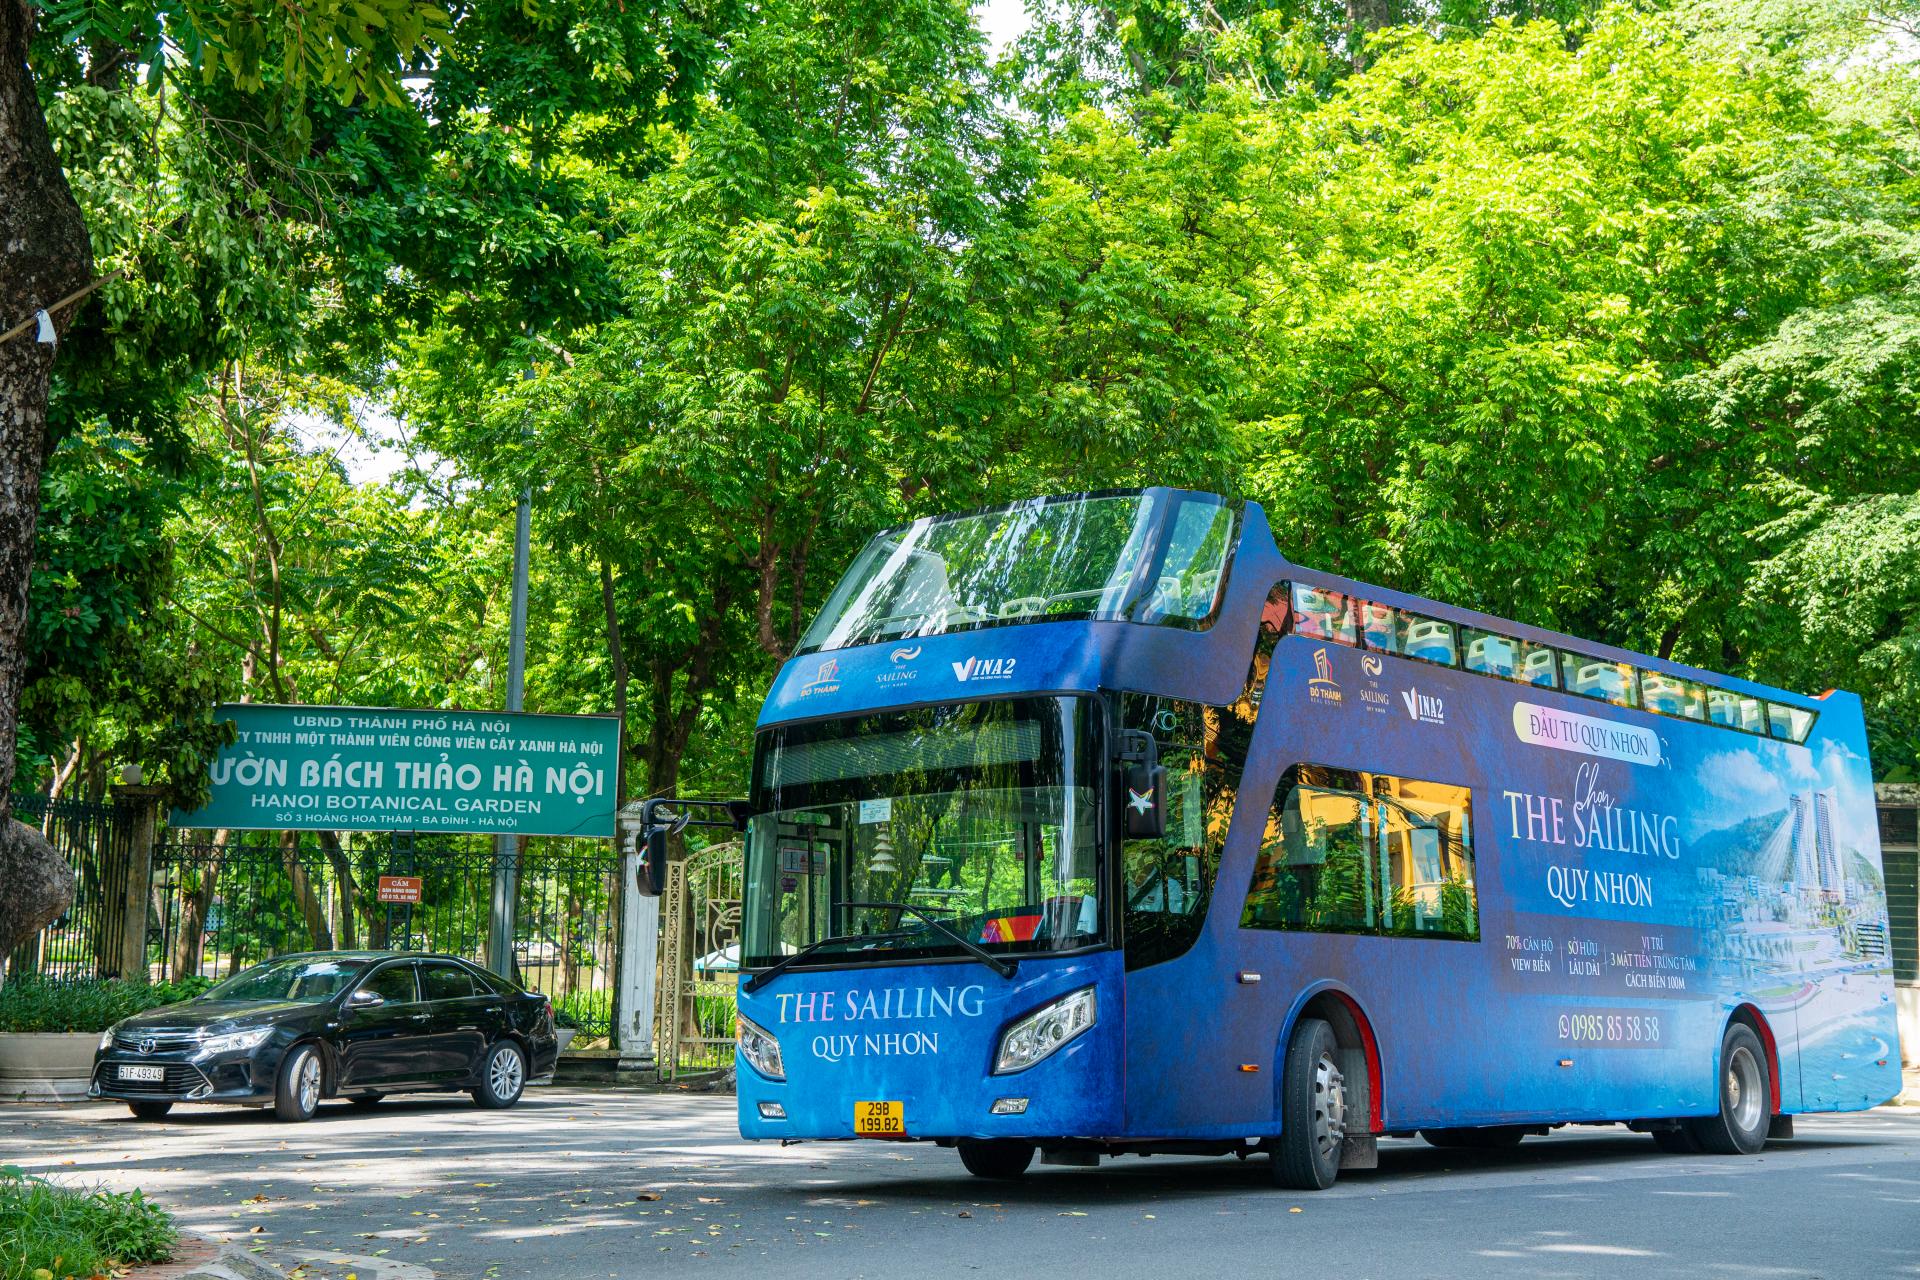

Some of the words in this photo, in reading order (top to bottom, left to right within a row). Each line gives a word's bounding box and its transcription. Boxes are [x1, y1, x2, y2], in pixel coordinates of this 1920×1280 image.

[875, 670, 918, 683] SAILING
[952, 655, 1016, 682] VINA2
[1320, 688, 1341, 701] THÀNH
[1360, 689, 1389, 705] SAILING
[1401, 686, 1444, 721] VINA2
[293, 716, 343, 728] UBND
[348, 715, 407, 730] THÀNH
[412, 715, 447, 731] PHỐ
[452, 718, 476, 732] HÀ
[481, 720, 510, 736] NỘI
[1530, 708, 1558, 740] ĐẦU
[1560, 720, 1579, 743] TƯ
[1581, 725, 1608, 752] QUY
[1610, 731, 1649, 757] NHƠN
[254, 731, 291, 744] TNHH
[295, 731, 325, 748] MỘT
[330, 732, 375, 746] THÀNH
[379, 733, 410, 747] VIÊN
[414, 734, 451, 748] CÔNG
[455, 736, 486, 750] VIÊN
[489, 736, 516, 751] CÂY
[519, 740, 555, 753] XANH
[559, 739, 576, 753] HÀ
[580, 741, 603, 757] NỘI
[208, 751, 288, 787] ƯỜN
[300, 753, 384, 789] BÁCH
[395, 752, 481, 791] THẢO
[493, 759, 534, 792] HÀ
[545, 761, 604, 804] NỘI
[251, 794, 319, 809] HANOI
[326, 795, 448, 811] BOTANICAL
[454, 797, 541, 814] GARDEN
[296, 814, 302, 822] 3
[352, 814, 377, 823] HOA
[380, 813, 413, 824] THÁM
[422, 815, 438, 824] BA
[478, 816, 495, 826] HÀ
[497, 816, 517, 828] NỘI
[1503, 790, 1566, 845] THE
[1573, 801, 1681, 860] SAILING
[1547, 866, 1589, 908] QUY
[1594, 871, 1653, 908] NHƠN
[1506, 935, 1522, 950] 70%
[1541, 937, 1553, 955] HỘ
[1510, 958, 1531, 971] VIEW
[1610, 952, 1615, 966] 3
[1653, 955, 1680, 970] TRUNG
[1625, 971, 1647, 988] CÁCH
[1667, 977, 1686, 990] 100M
[775, 991, 835, 1025] THE
[844, 984, 985, 1021] SAILING
[1571, 1014, 1604, 1041] 0985
[1607, 1015, 1623, 1041] 85
[1626, 1016, 1641, 1041] 58
[1644, 1016, 1660, 1042] 58
[812, 1035, 857, 1062] QUY
[865, 1030, 939, 1056] NHƠN
[119, 1067, 162, 1080] 51F-493.49
[868, 1102, 890, 1116] 29B
[860, 1117, 899, 1132] 199.82
